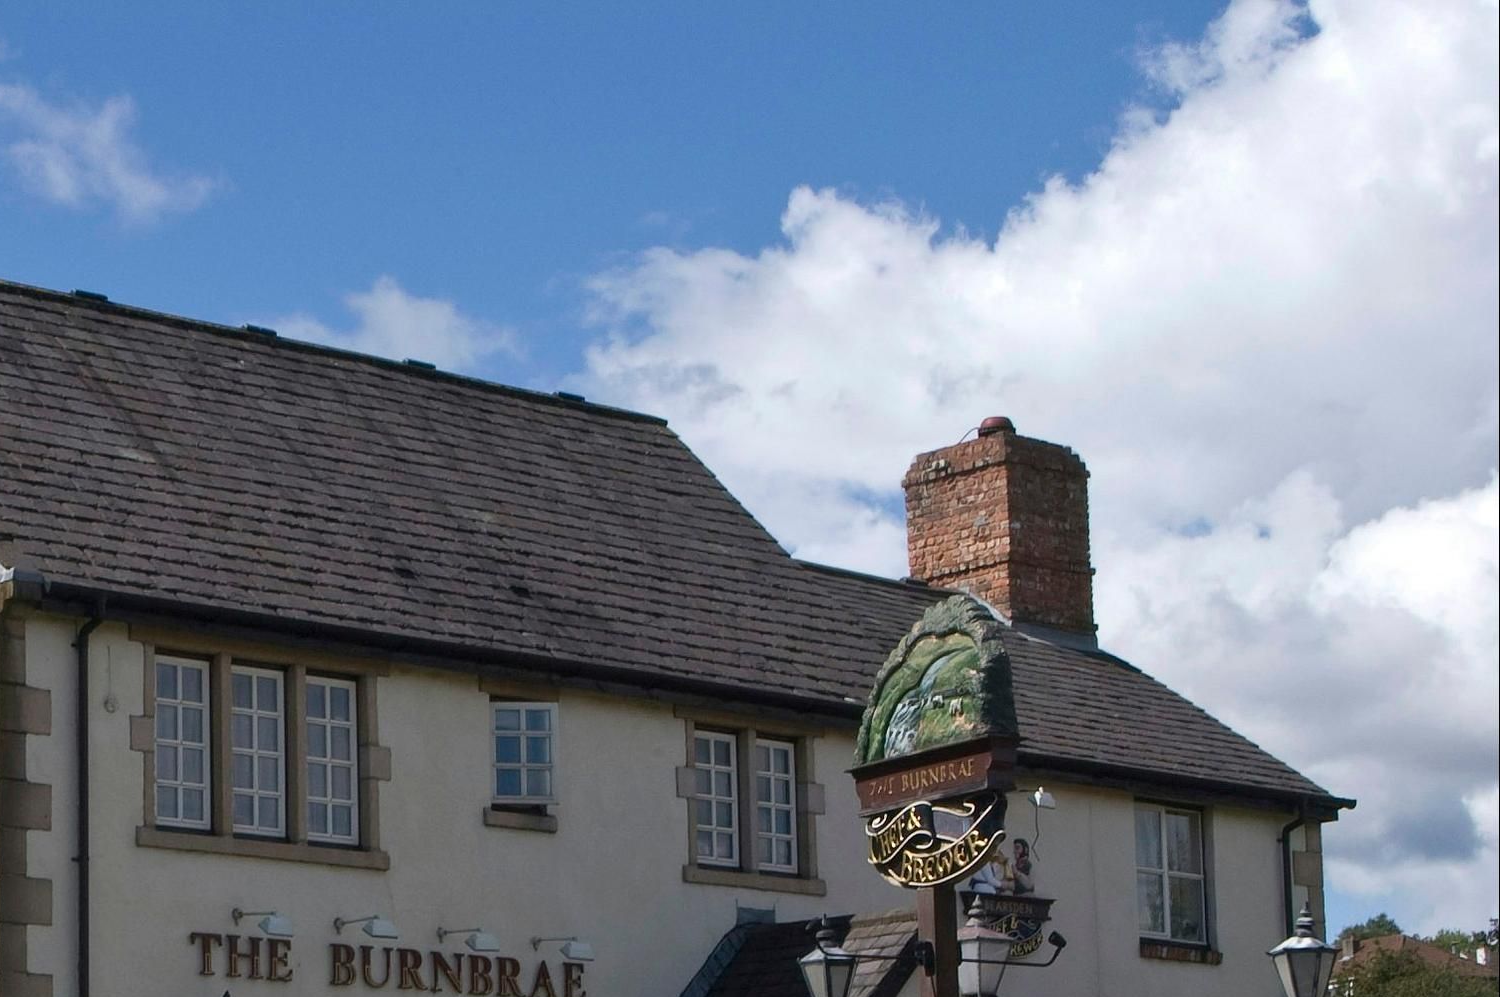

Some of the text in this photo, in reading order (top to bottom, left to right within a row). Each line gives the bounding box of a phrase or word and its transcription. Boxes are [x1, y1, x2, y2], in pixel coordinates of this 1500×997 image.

[906, 806, 922, 831] &
[900, 830, 988, 883] BREWER
[190, 931, 293, 983] THE
